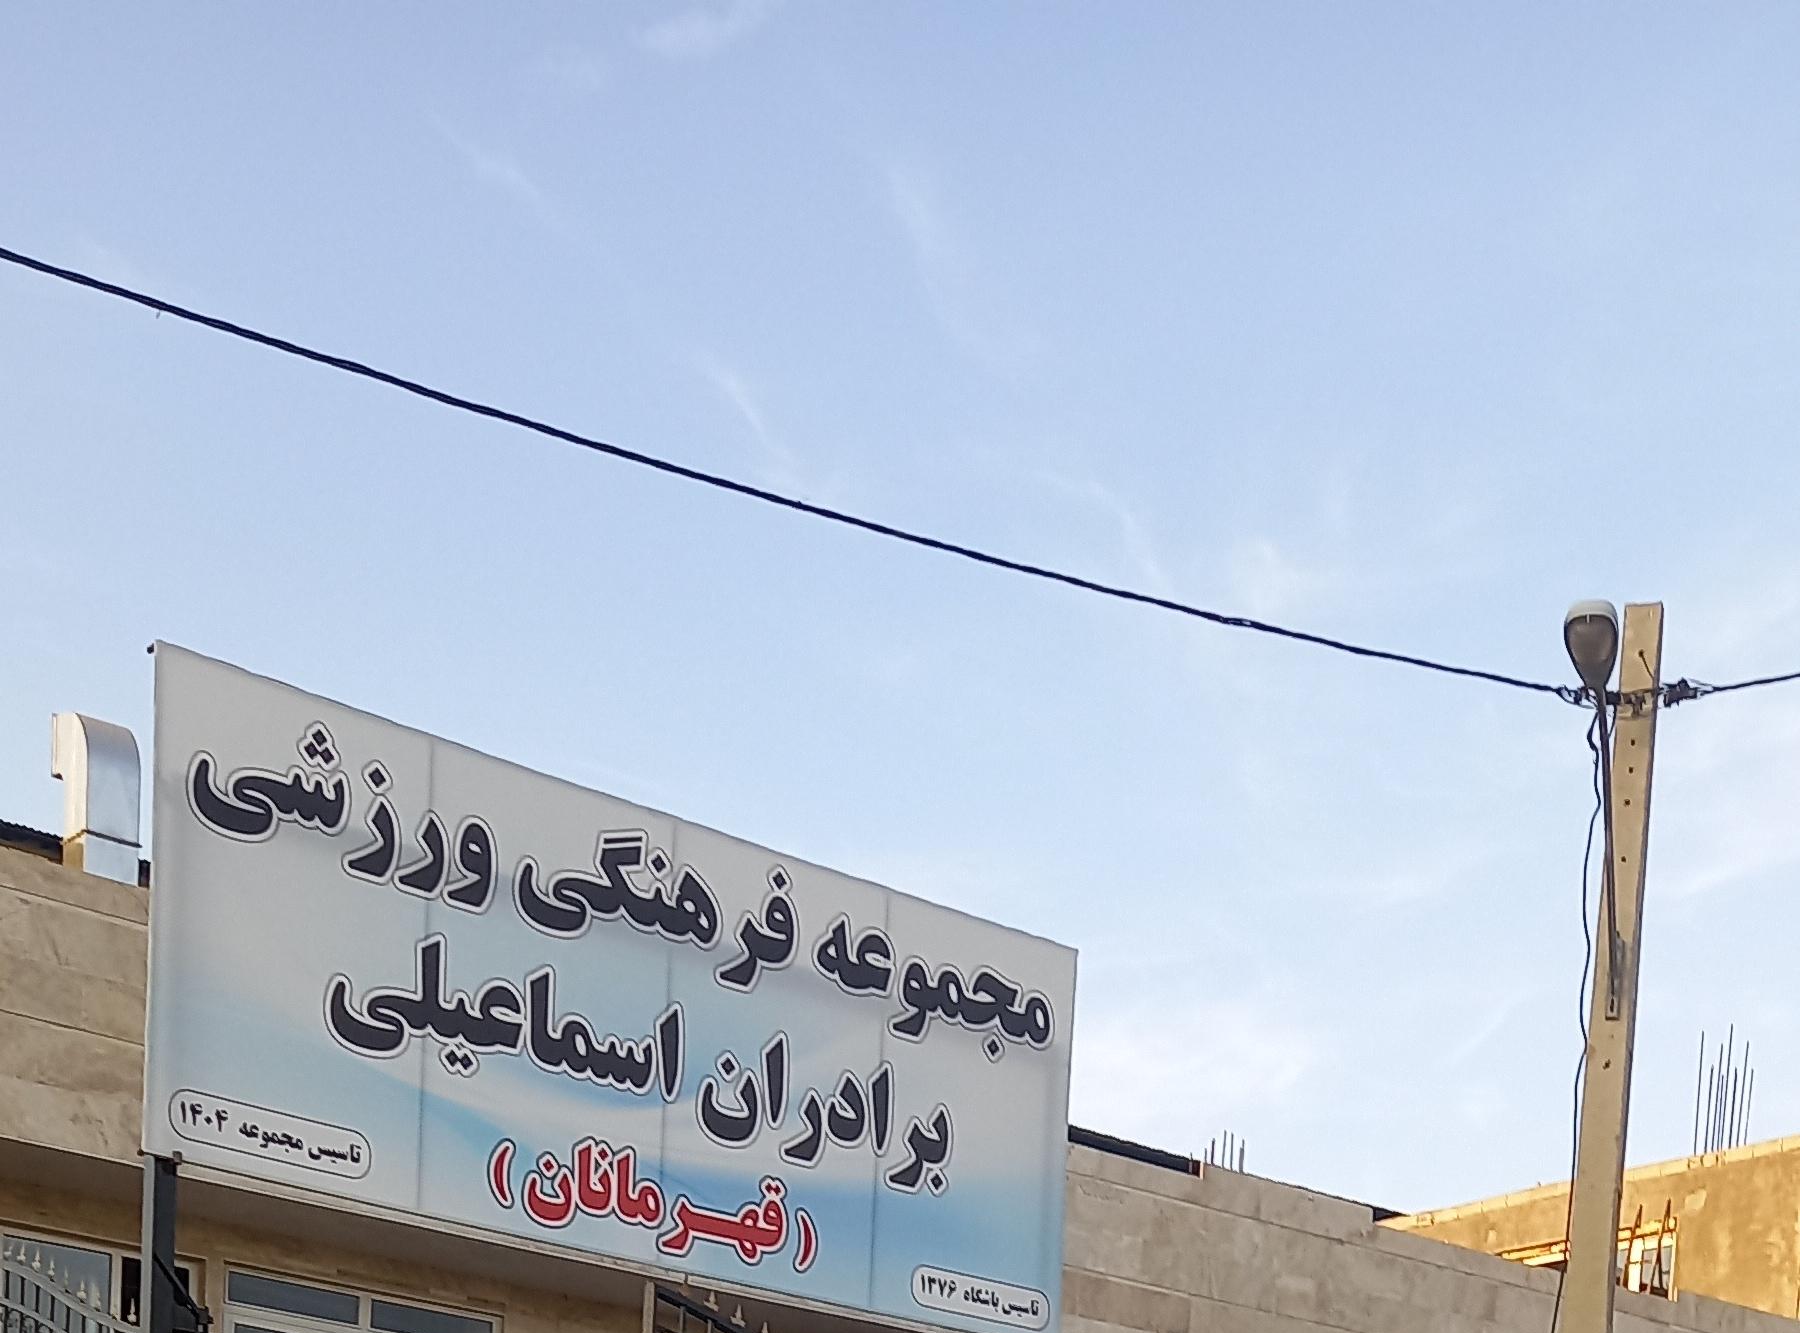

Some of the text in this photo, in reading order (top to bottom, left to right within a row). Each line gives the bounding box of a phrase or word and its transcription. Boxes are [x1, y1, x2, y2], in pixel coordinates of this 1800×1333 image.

[192, 727, 1052, 1059] مجموعه فرهنگی ورزشی
[329, 939, 951, 1193] برادران اسماعیلی
[179, 1100, 363, 1165] تاسیس مجموعه ۱۴۰۴
[963, 1286, 1000, 1312] باشگاه
[1001, 1299, 1040, 1318] تاسیس
